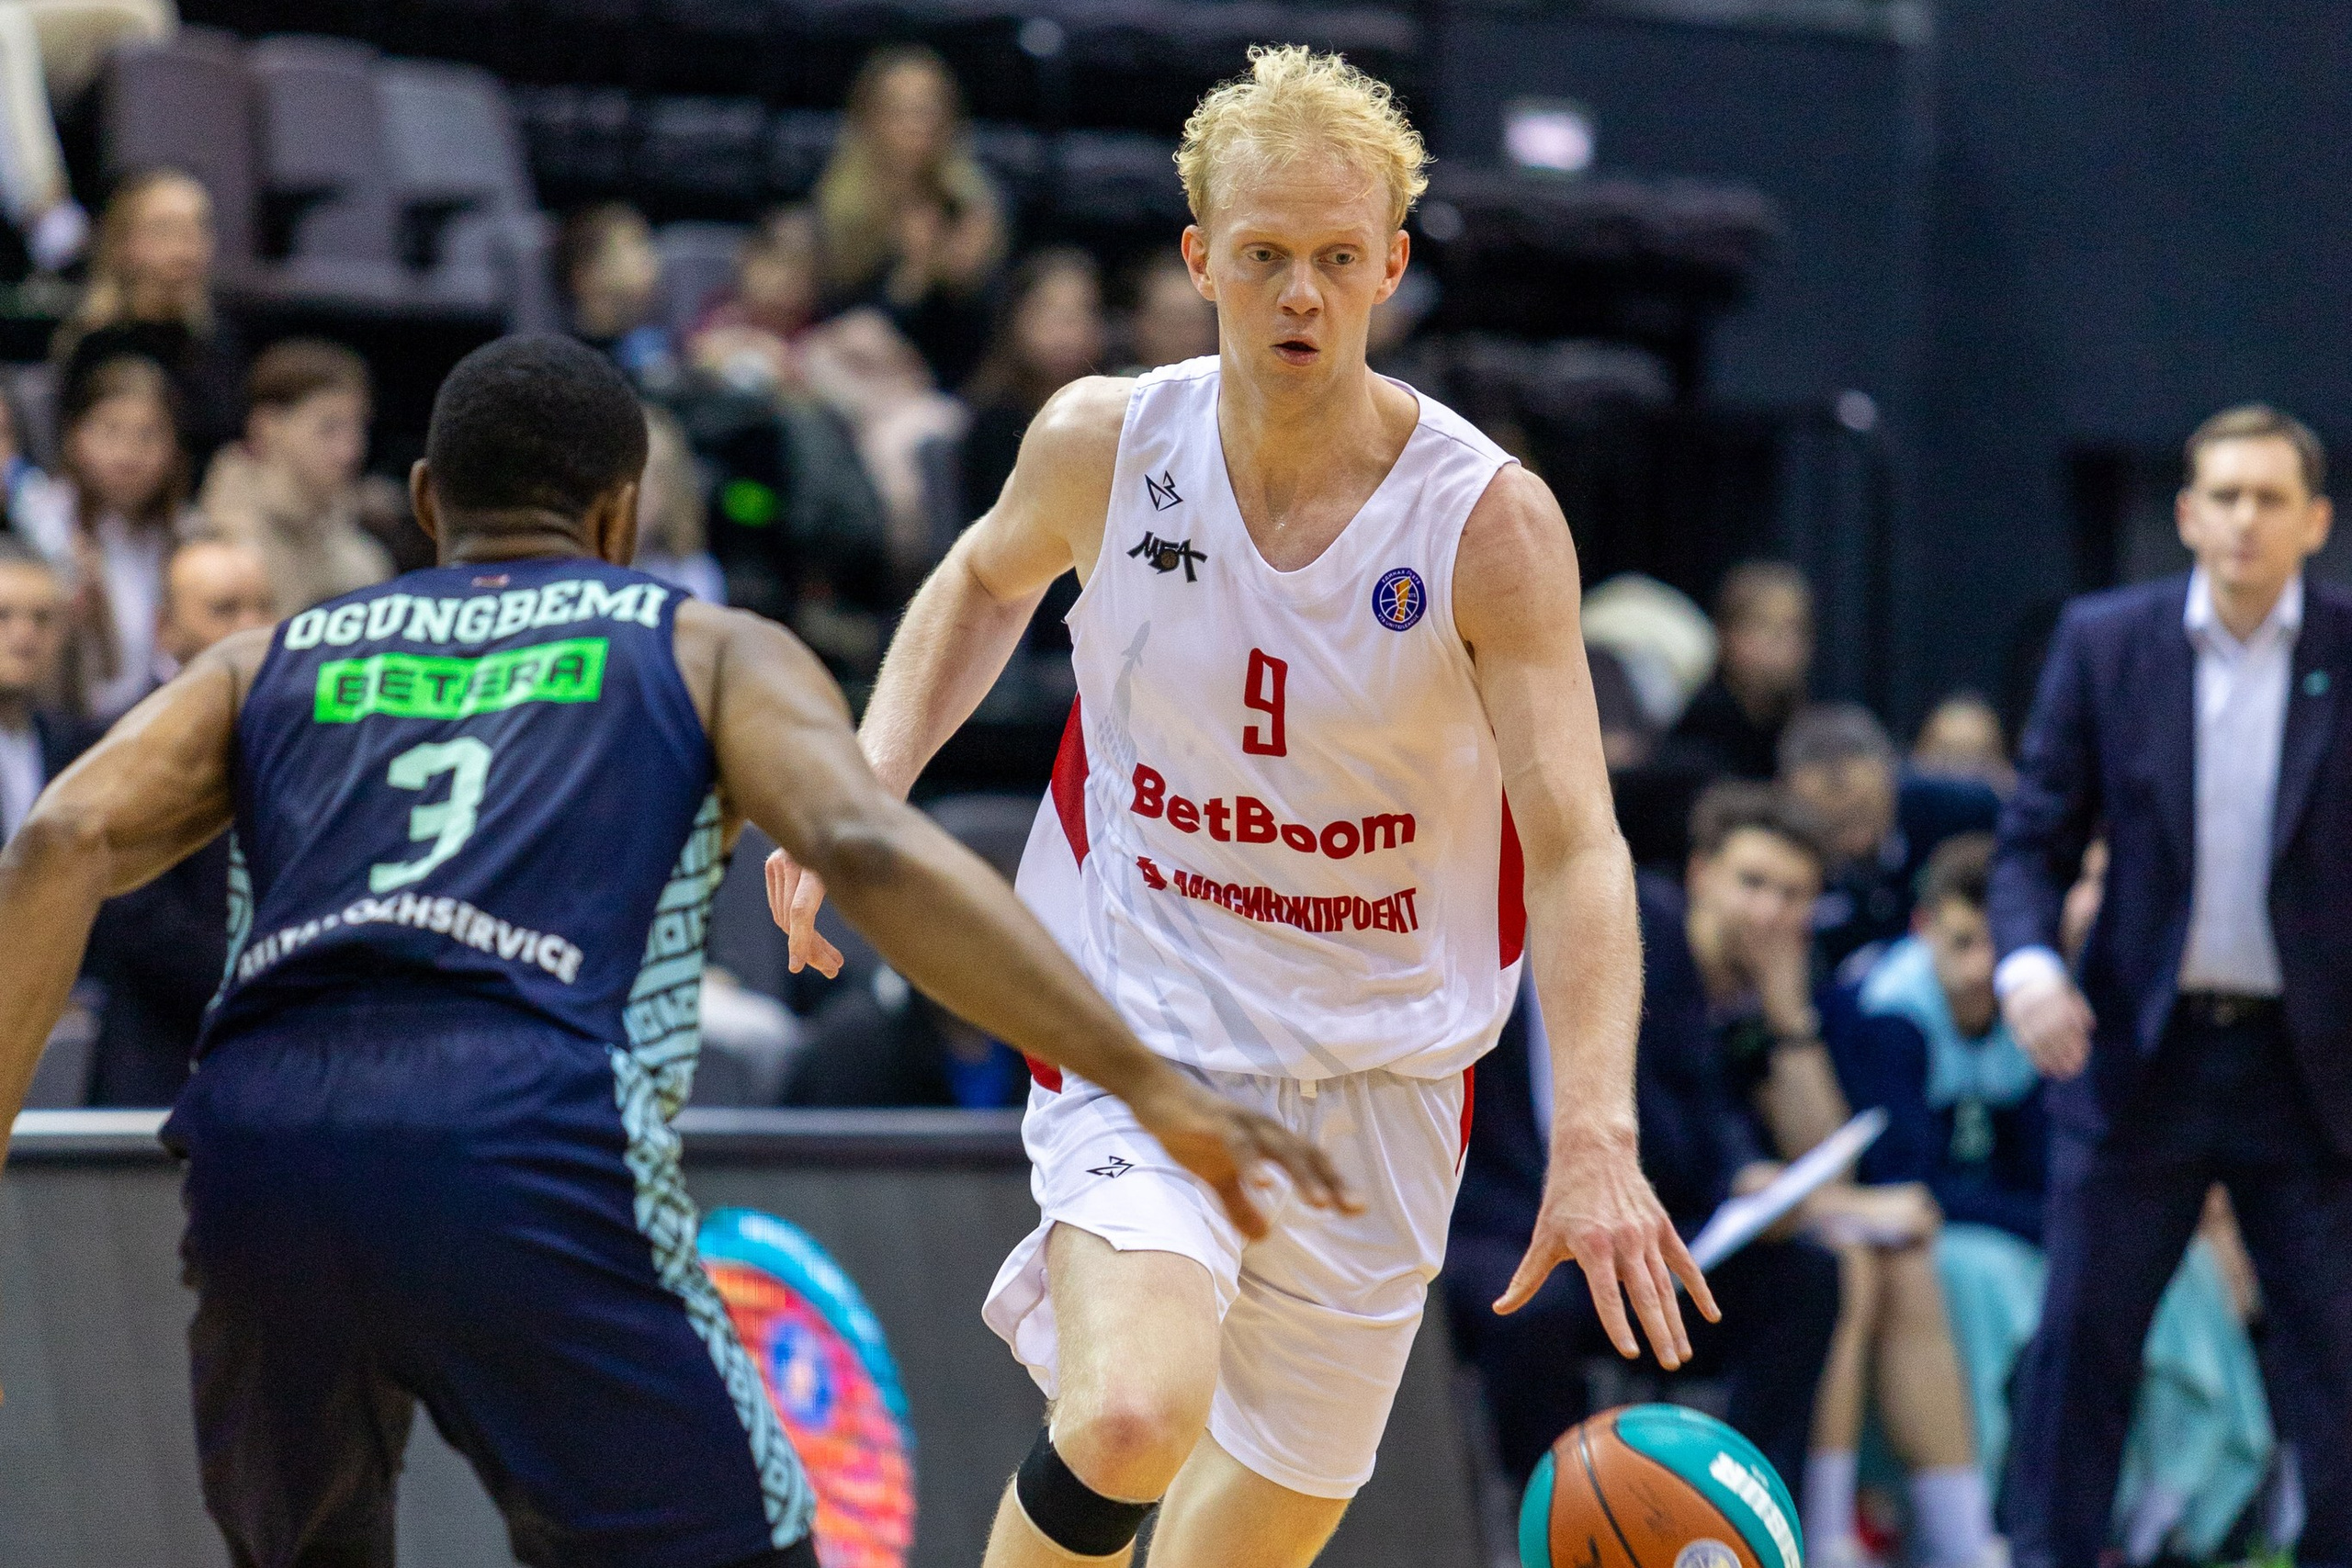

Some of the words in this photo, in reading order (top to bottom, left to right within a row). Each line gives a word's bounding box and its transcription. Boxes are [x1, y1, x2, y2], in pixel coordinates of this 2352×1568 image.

[284, 580, 668, 649] OGUNGBEMI
[336, 655, 584, 705] BETERA
[1242, 648, 1288, 757] 9
[369, 737, 492, 894] 3
[1130, 762, 1416, 860] BetBoom
